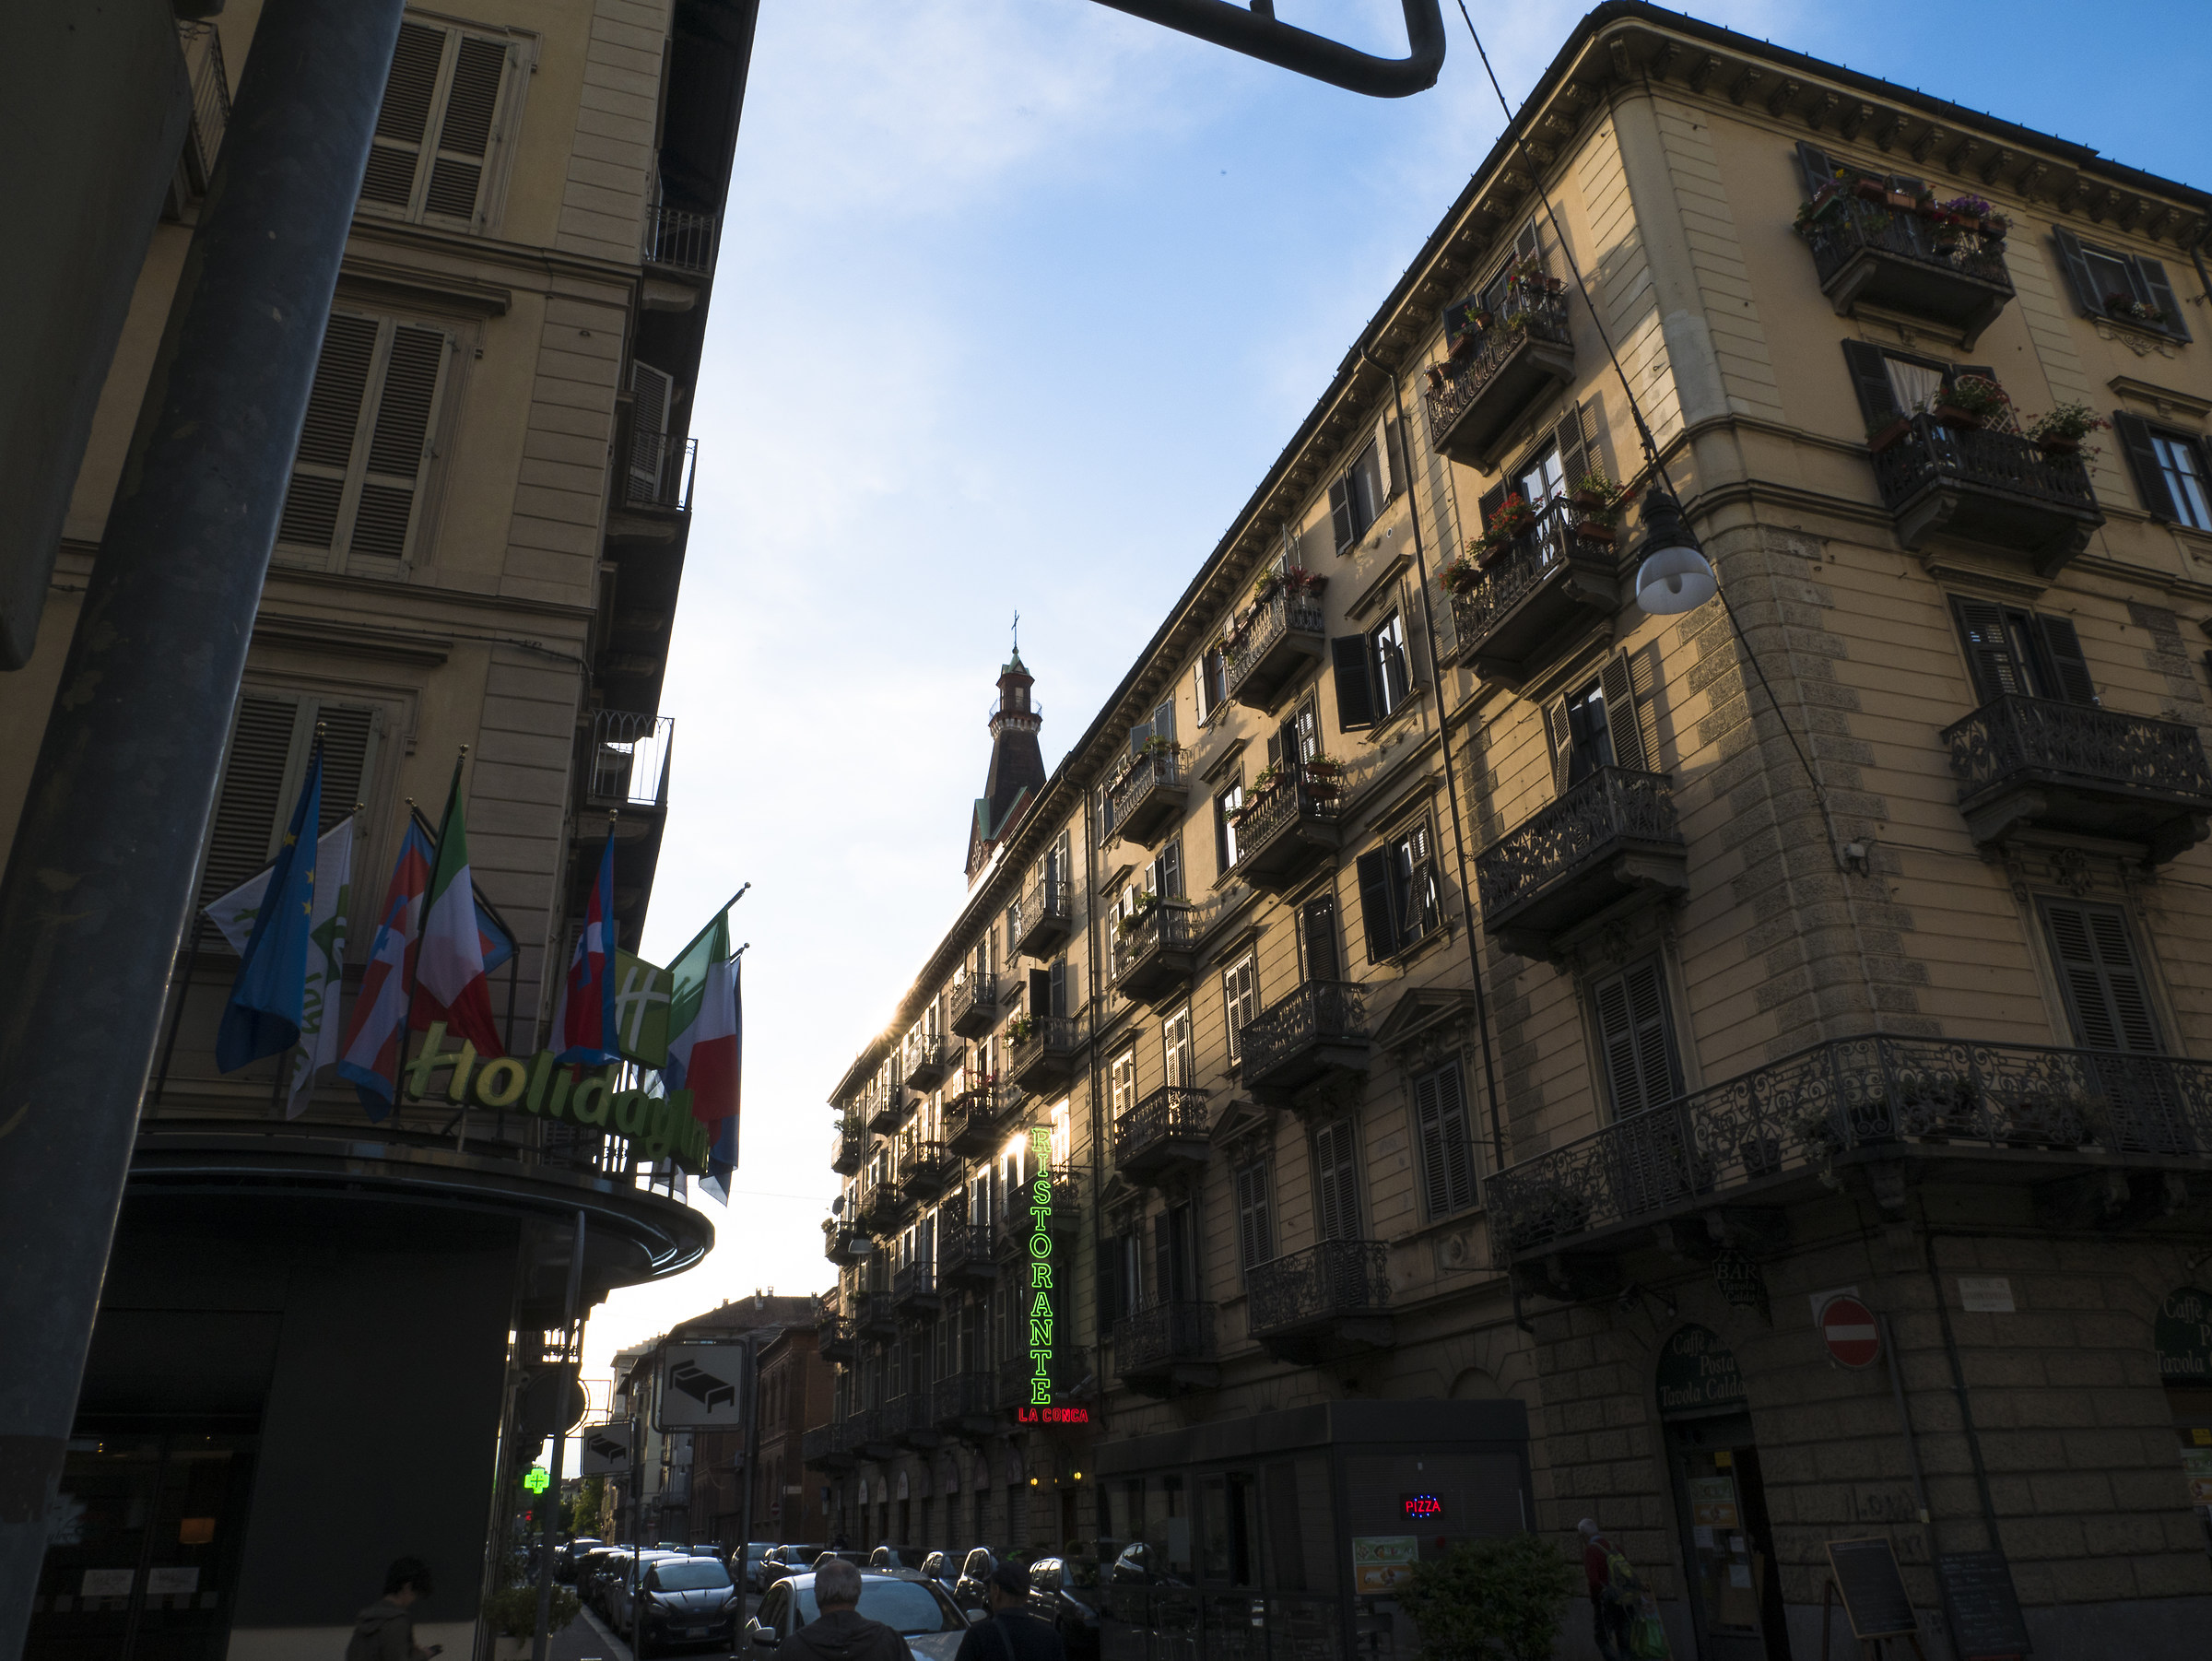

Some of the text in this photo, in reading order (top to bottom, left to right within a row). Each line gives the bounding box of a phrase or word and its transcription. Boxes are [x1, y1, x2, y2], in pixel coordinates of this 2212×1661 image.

[405, 1020, 675, 1162] Holiday
[1029, 1127, 1053, 1405] RISTORANTE
[1717, 1264, 1760, 1281] BAR
[1722, 1280, 1756, 1291] Tavola
[1725, 1290, 1755, 1302] Calda
[1700, 1355, 1735, 1376] Posta
[2156, 1349, 2205, 1373] Tavola
[1660, 1374, 1747, 1407] Tavola Calda
[1018, 1408, 1089, 1422] LA CONCA
[1406, 1501, 1441, 1513] PIZZA
